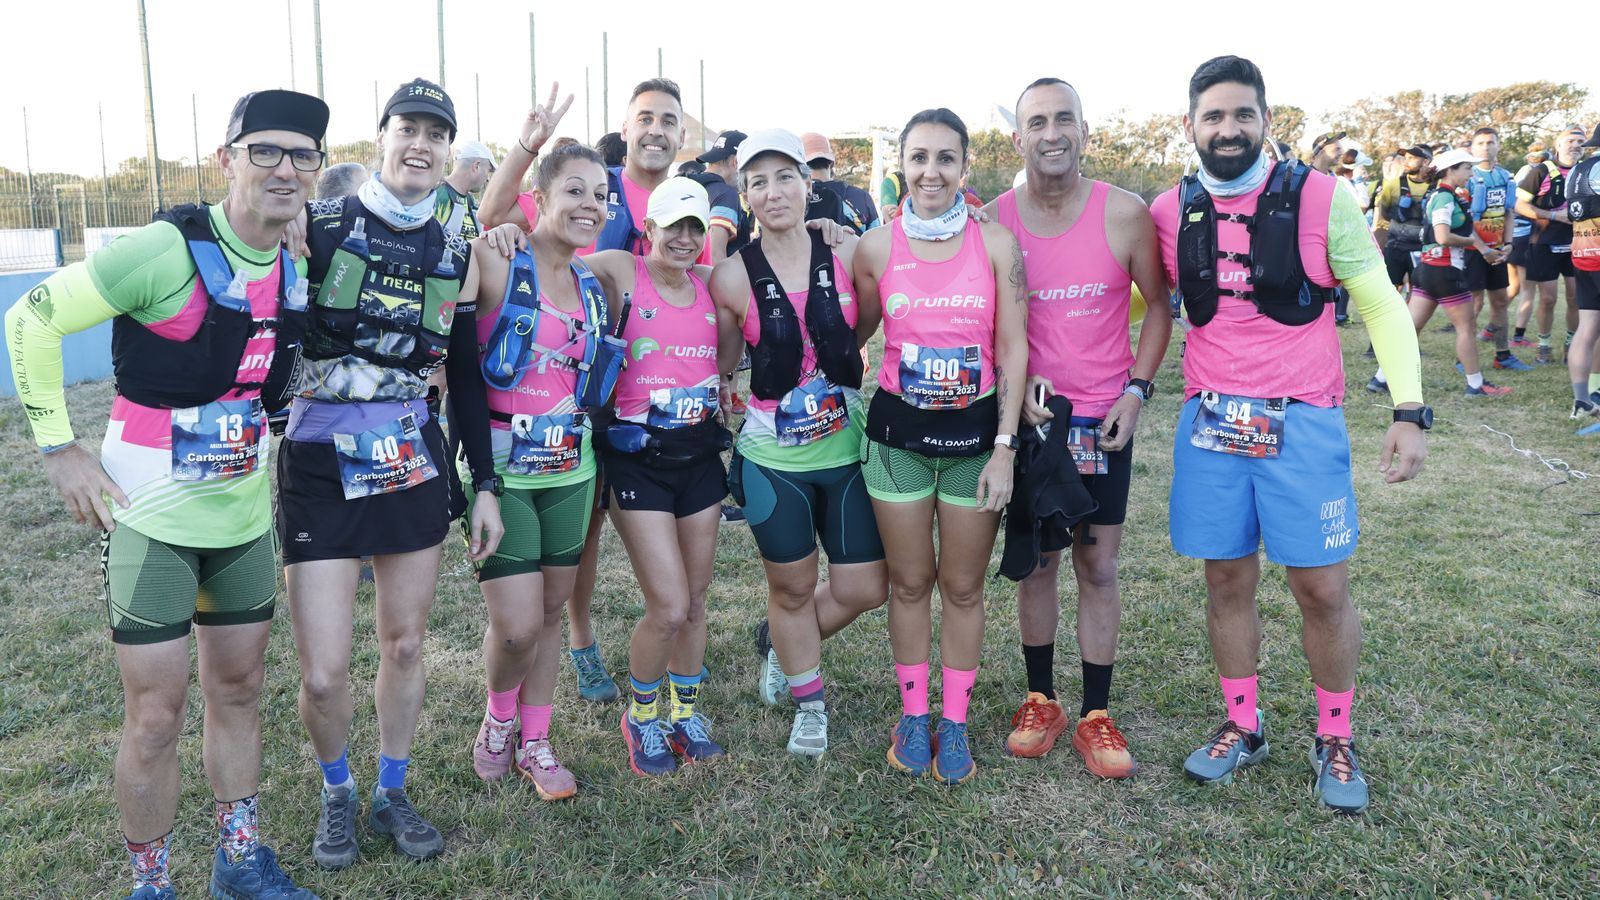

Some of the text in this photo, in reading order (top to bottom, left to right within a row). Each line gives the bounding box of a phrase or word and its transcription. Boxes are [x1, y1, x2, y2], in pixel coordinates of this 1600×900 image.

[333, 262, 350, 288] MAX
[951, 316, 979, 325] chiclana
[1066, 307, 1100, 318] chiclana
[15, 348, 32, 397] FACTORY
[636, 374, 677, 385] chiclana
[923, 358, 960, 381] 190
[907, 385, 954, 396] Carbonera
[956, 386, 977, 396] 2023
[676, 397, 704, 419] 125
[804, 393, 818, 415] 6
[1224, 400, 1251, 425] 94
[216, 413, 243, 442] 13
[785, 418, 828, 433] Carbonera
[828, 408, 845, 421] 2023
[543, 425, 564, 447] 10
[922, 436, 980, 447] SALOMON
[1204, 426, 1250, 441] Carbonera
[1252, 434, 1278, 445] 2023
[187, 452, 245, 462] Carbonera
[371, 435, 399, 463] 40
[520, 454, 562, 462] Carbonera
[563, 449, 579, 460] 2023
[354, 468, 405, 481] Carbonera
[406, 457, 428, 471] 2023
[1325, 529, 1351, 550] NIKE
